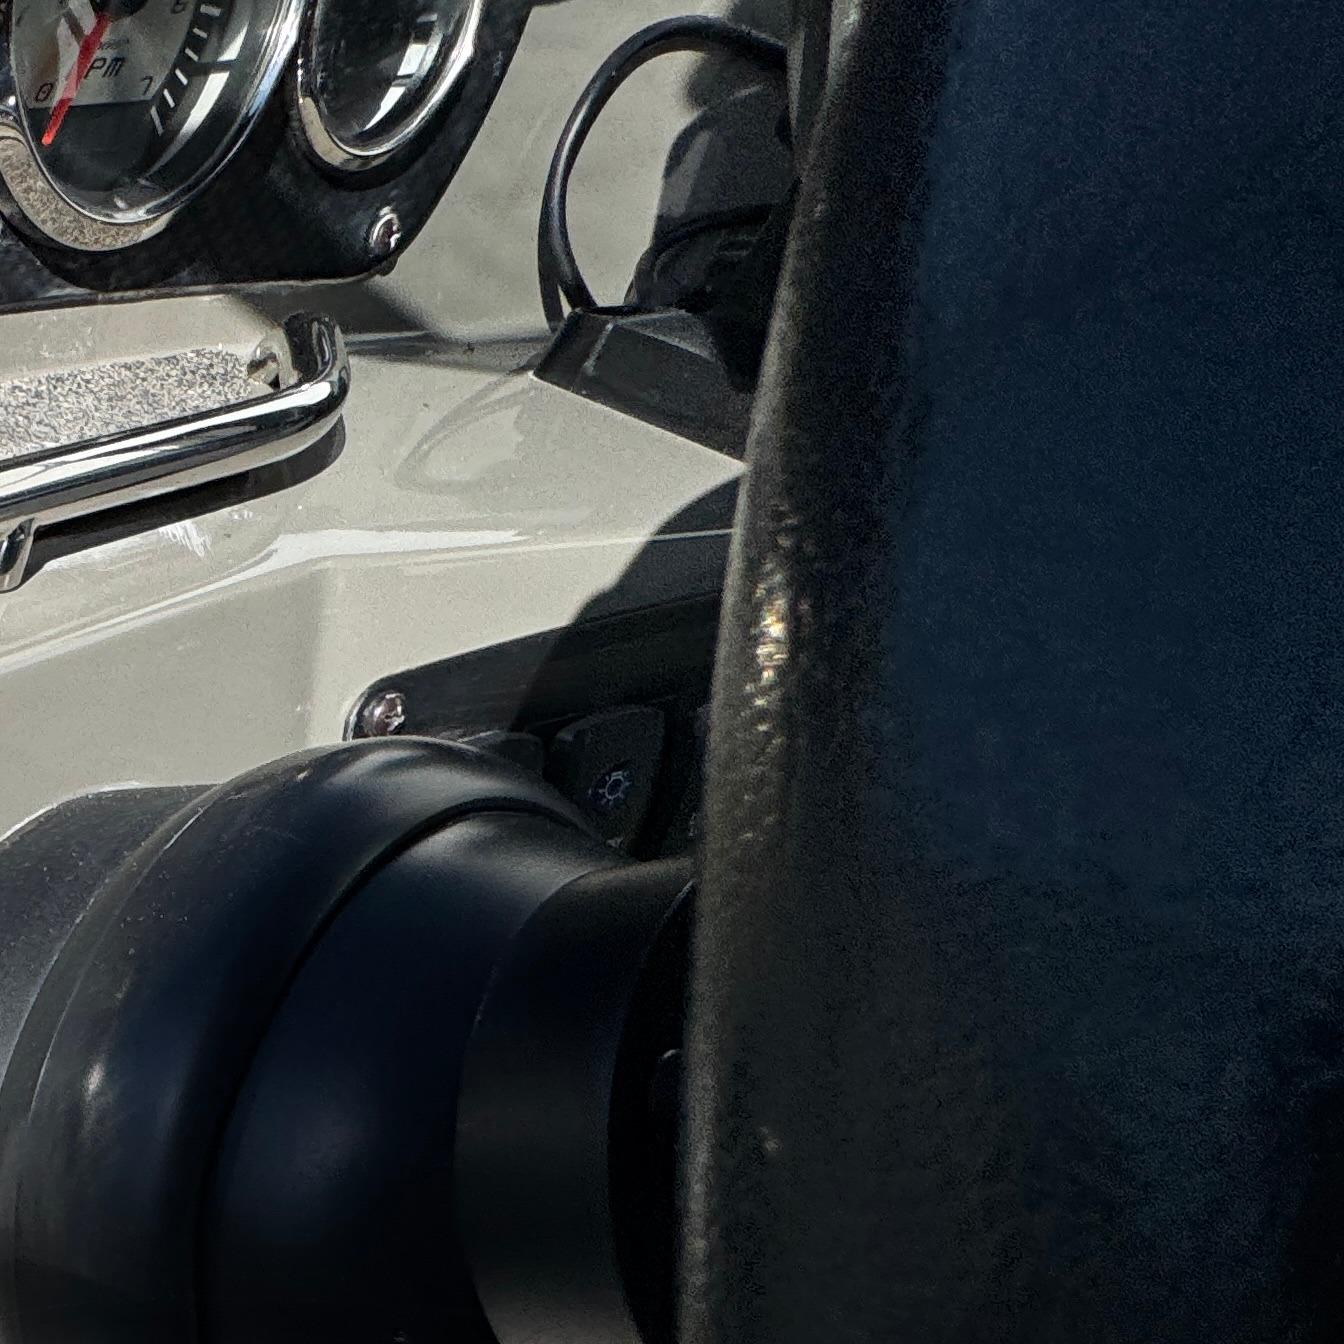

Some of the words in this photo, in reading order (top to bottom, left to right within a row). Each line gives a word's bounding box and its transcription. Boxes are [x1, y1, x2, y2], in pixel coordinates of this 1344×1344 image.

[83, 56, 125, 79] PM
[35, 82, 54, 102] 0
[141, 75, 154, 96] 7
